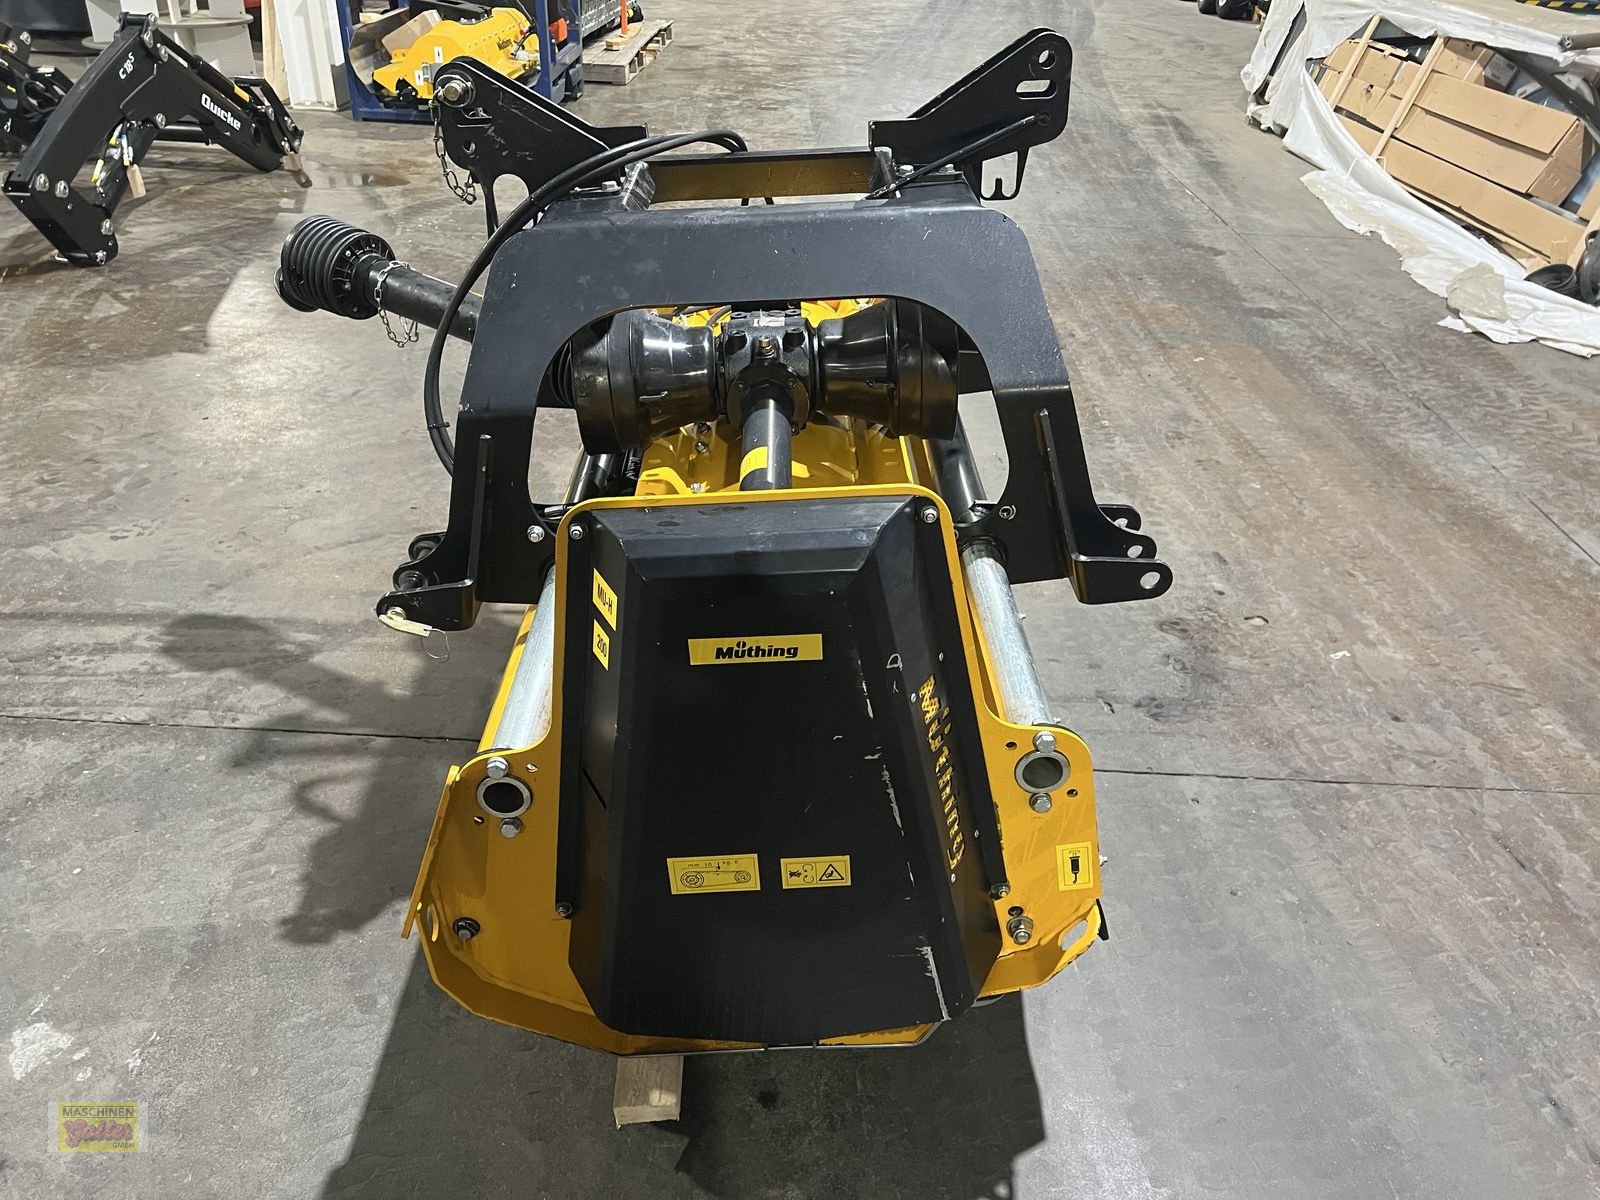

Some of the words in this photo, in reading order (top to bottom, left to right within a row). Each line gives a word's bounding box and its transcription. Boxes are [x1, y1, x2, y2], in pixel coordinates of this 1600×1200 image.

[201, 93, 241, 131] Quicke
[597, 582, 613, 616] MU-H
[596, 633, 608, 658] 200
[715, 640, 799, 660] Müthing
[919, 674, 965, 870] Müthing
